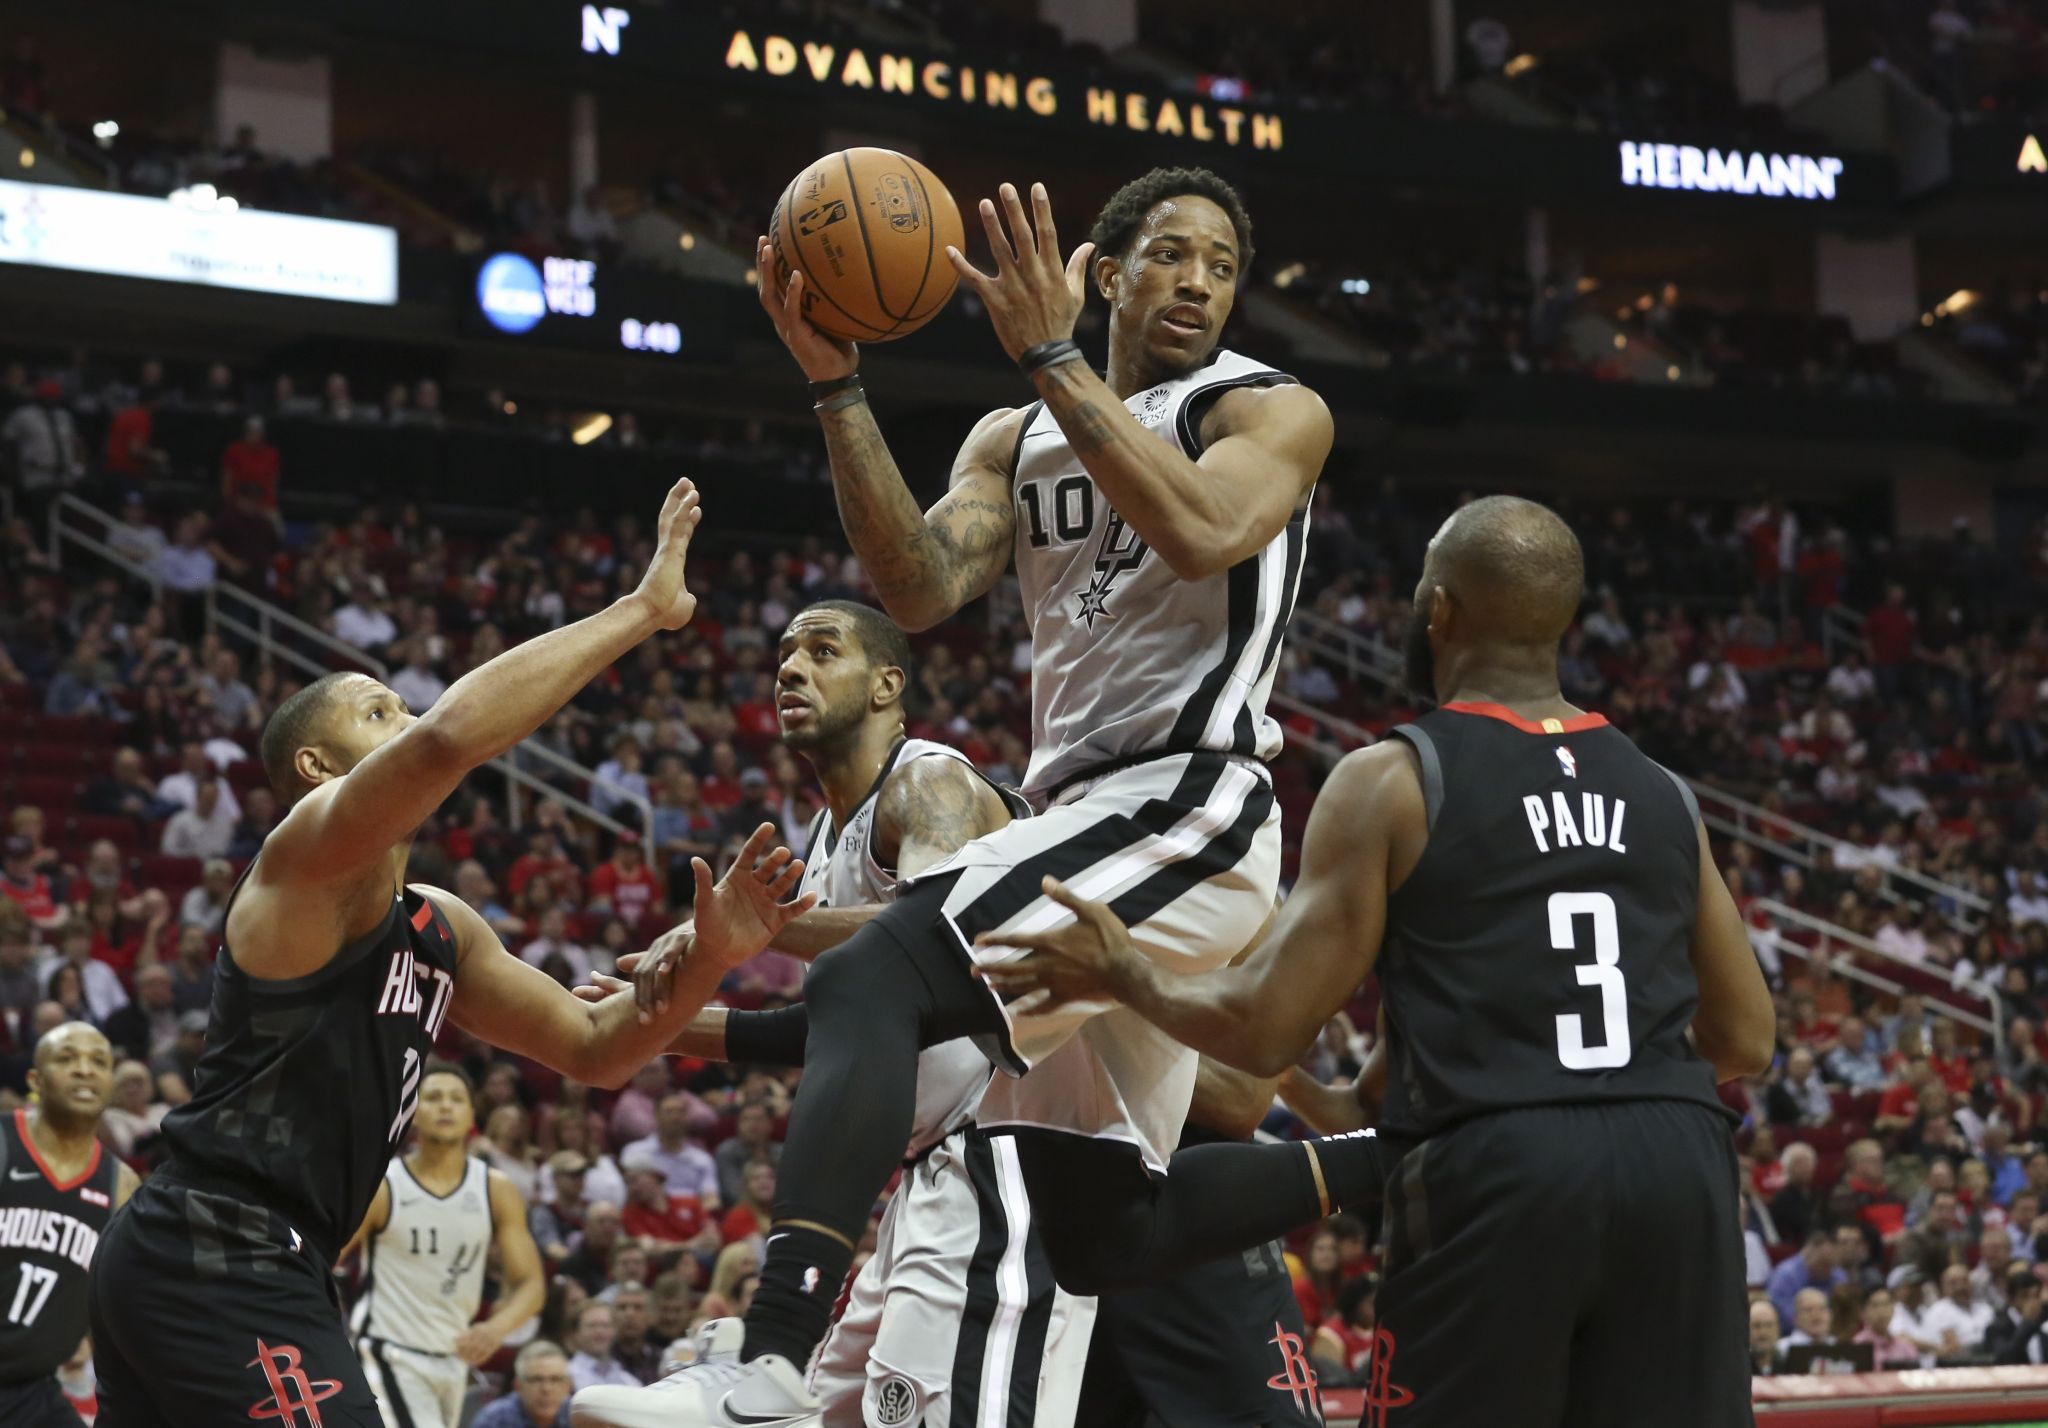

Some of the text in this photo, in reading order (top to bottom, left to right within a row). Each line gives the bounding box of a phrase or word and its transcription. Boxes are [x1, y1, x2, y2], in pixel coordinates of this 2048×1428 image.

[726, 31, 1283, 151] ADVANCING HEALTH
[1619, 140, 1843, 200] HERMANN
[1018, 474, 1095, 549] 10
[1522, 791, 1627, 853] PAUL
[1547, 892, 1631, 1070] 3
[409, 1226, 438, 1255] 11
[7, 1261, 59, 1327] 17
